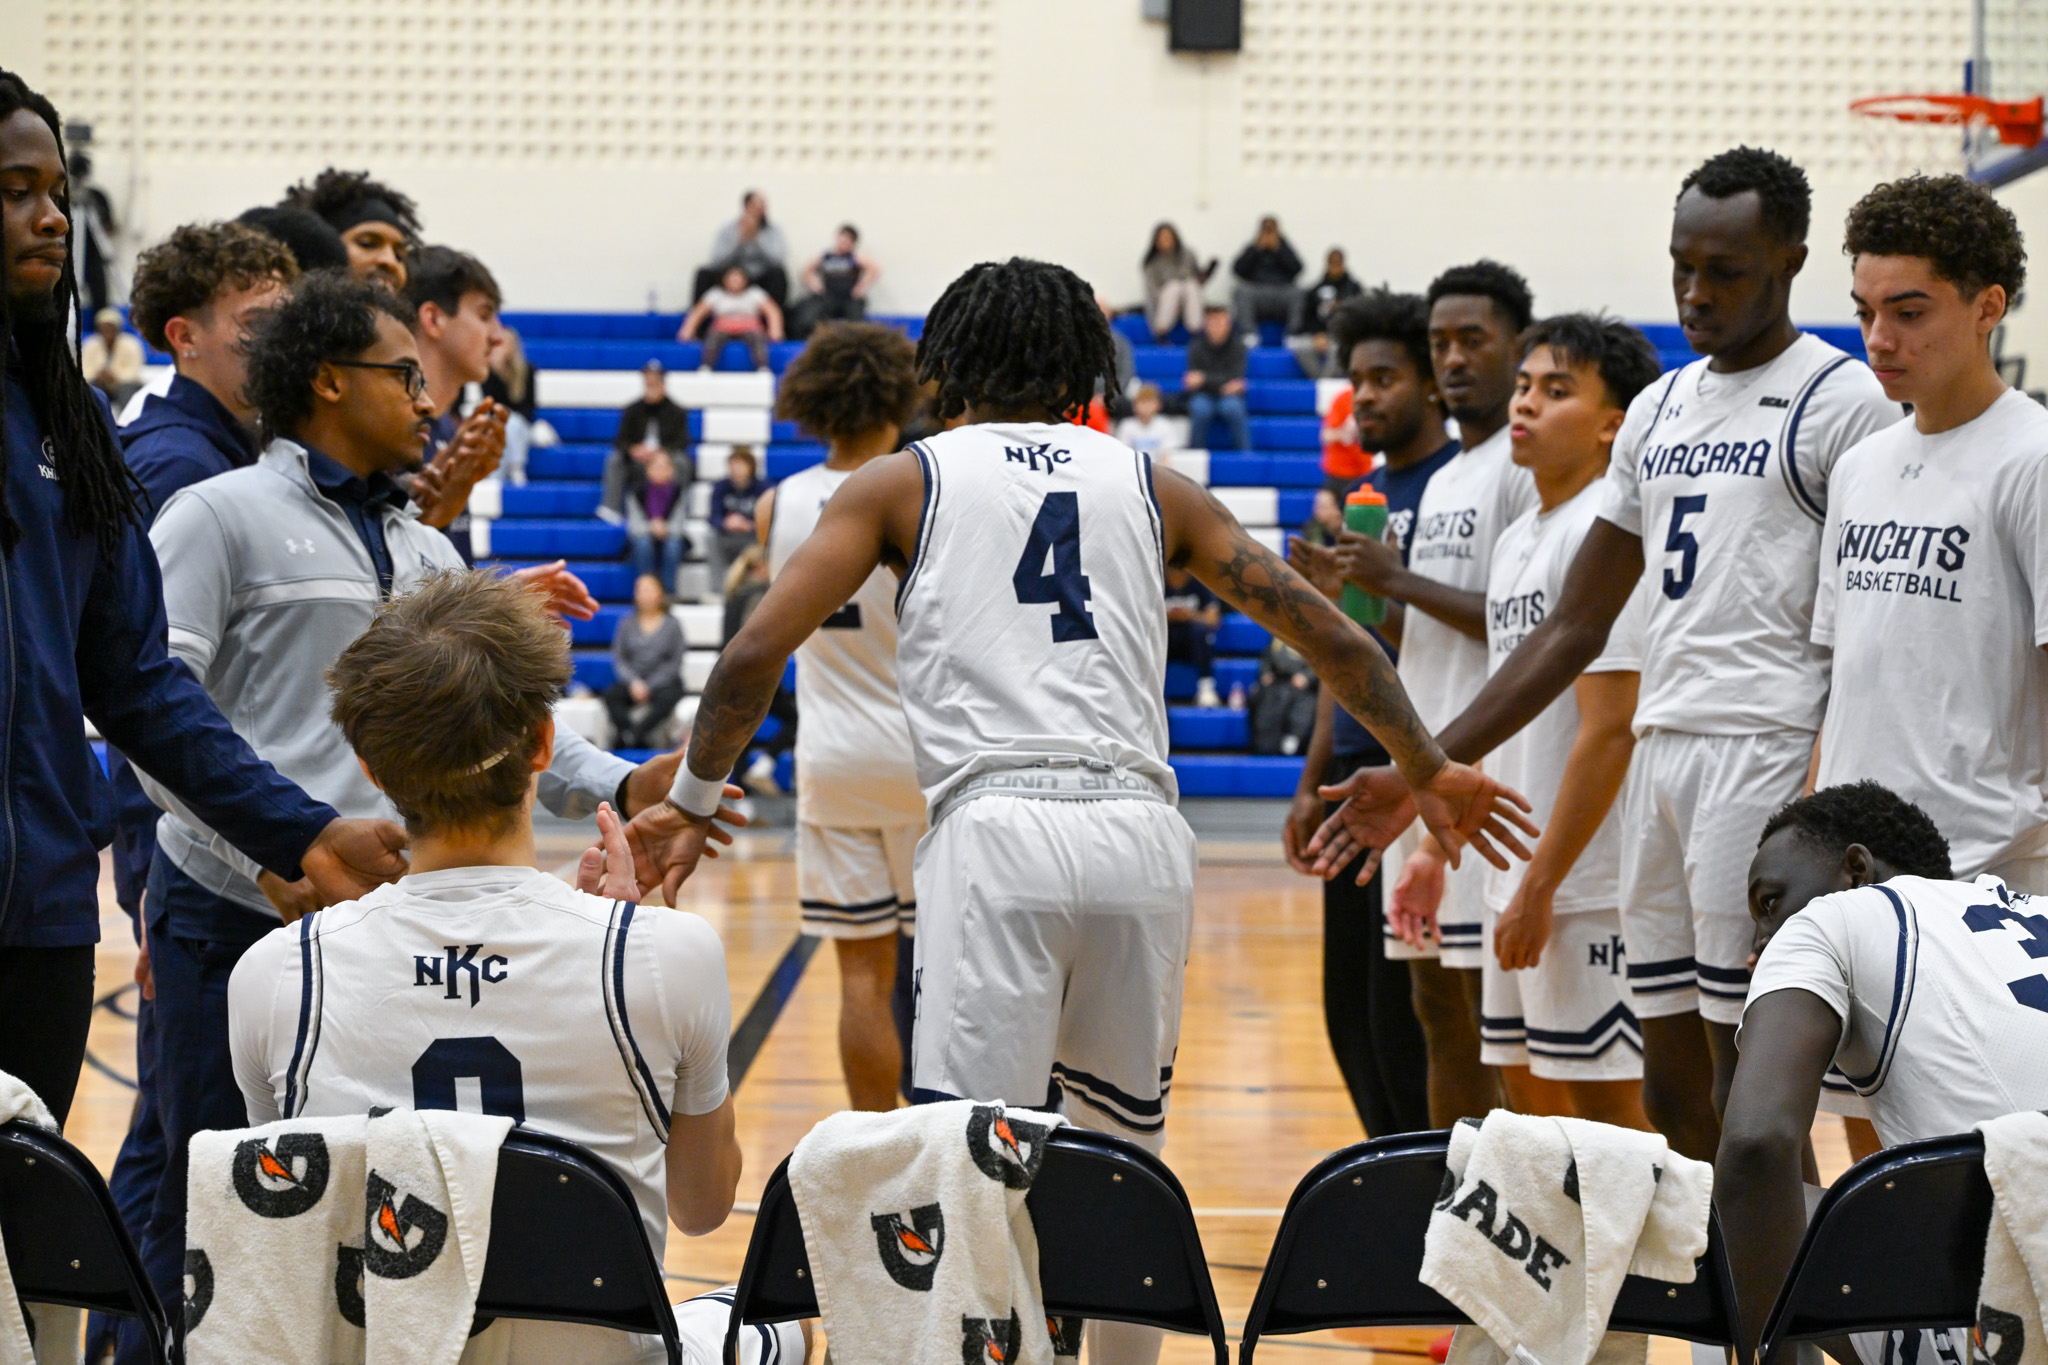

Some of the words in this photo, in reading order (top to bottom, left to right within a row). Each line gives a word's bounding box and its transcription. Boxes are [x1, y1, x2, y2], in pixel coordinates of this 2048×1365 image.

[1003, 443, 1072, 475] NKC
[1638, 439, 1771, 483] NIAGARA
[1013, 491, 1099, 643] 4
[1662, 494, 1708, 600] 5
[1846, 570, 1962, 603] BASKETBALL
[413, 943, 508, 1009] NKC
